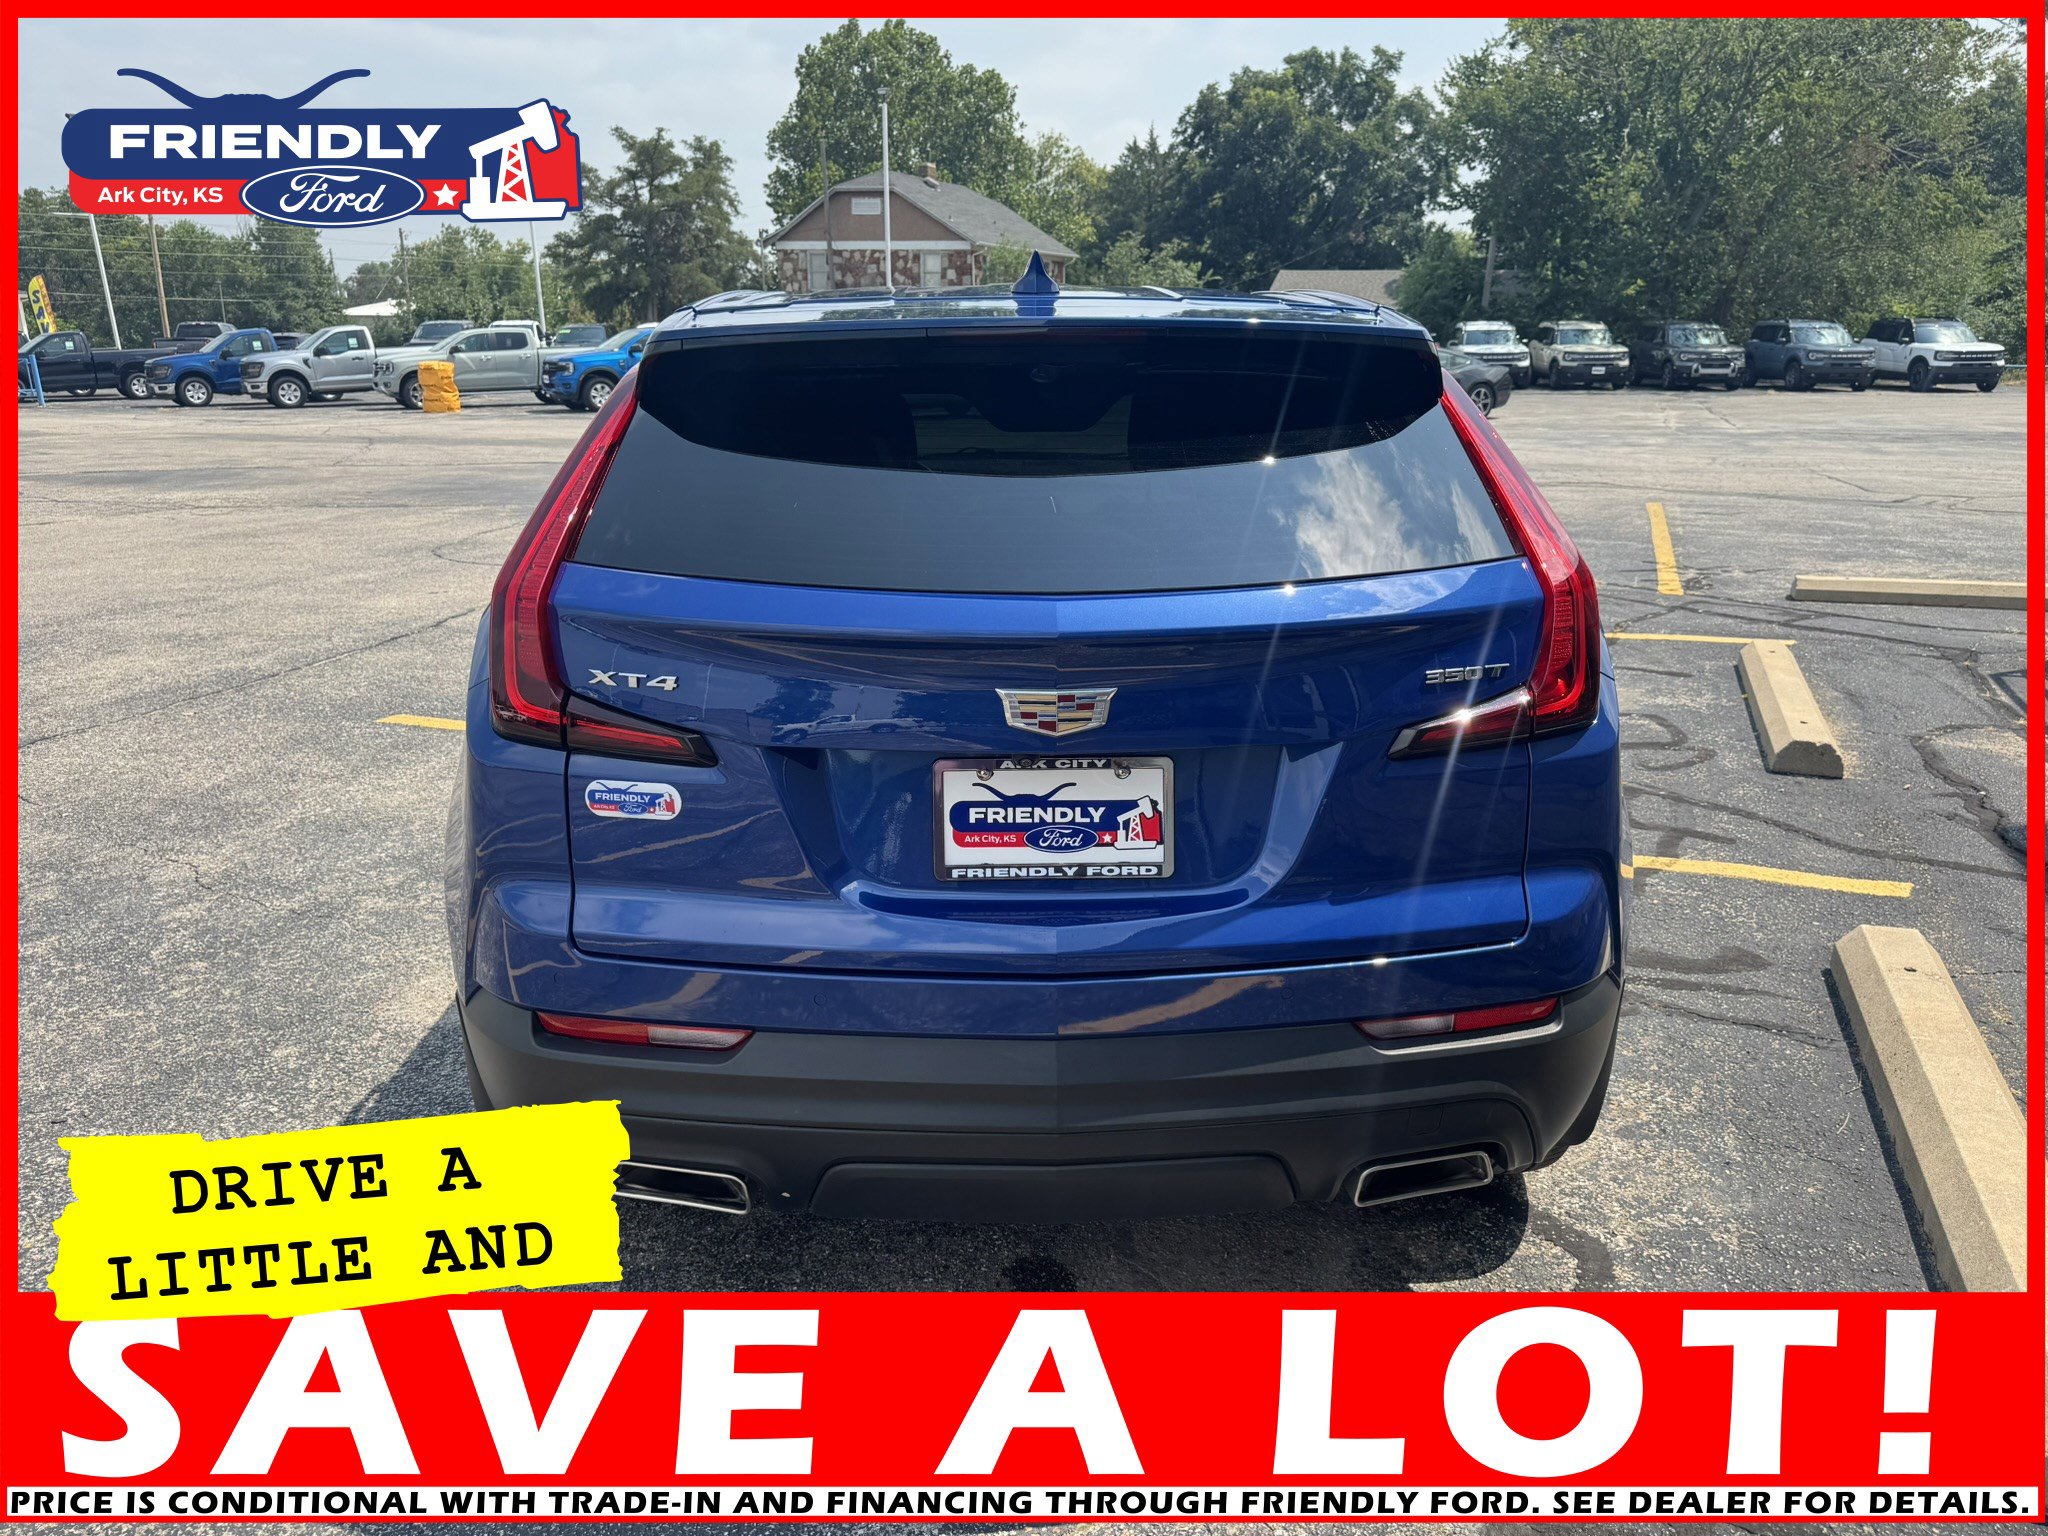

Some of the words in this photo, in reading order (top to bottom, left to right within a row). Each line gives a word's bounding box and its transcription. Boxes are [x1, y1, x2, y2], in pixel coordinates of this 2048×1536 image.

[588, 668, 679, 691] XT4
[1425, 663, 1510, 684] 350T
[1000, 759, 1048, 769] AK
[1054, 758, 1108, 769] CITY
[594, 792, 651, 803] FRIENDLY
[623, 802, 642, 813] Ford
[968, 806, 1106, 824] FRIENDLY
[964, 835, 980, 843] Ark
[981, 835, 1002, 845] City,
[1003, 835, 1017, 843] KS
[1039, 828, 1083, 848] Ford
[951, 866, 1080, 879] FRIENDLY
[1086, 865, 1159, 877] FORD
